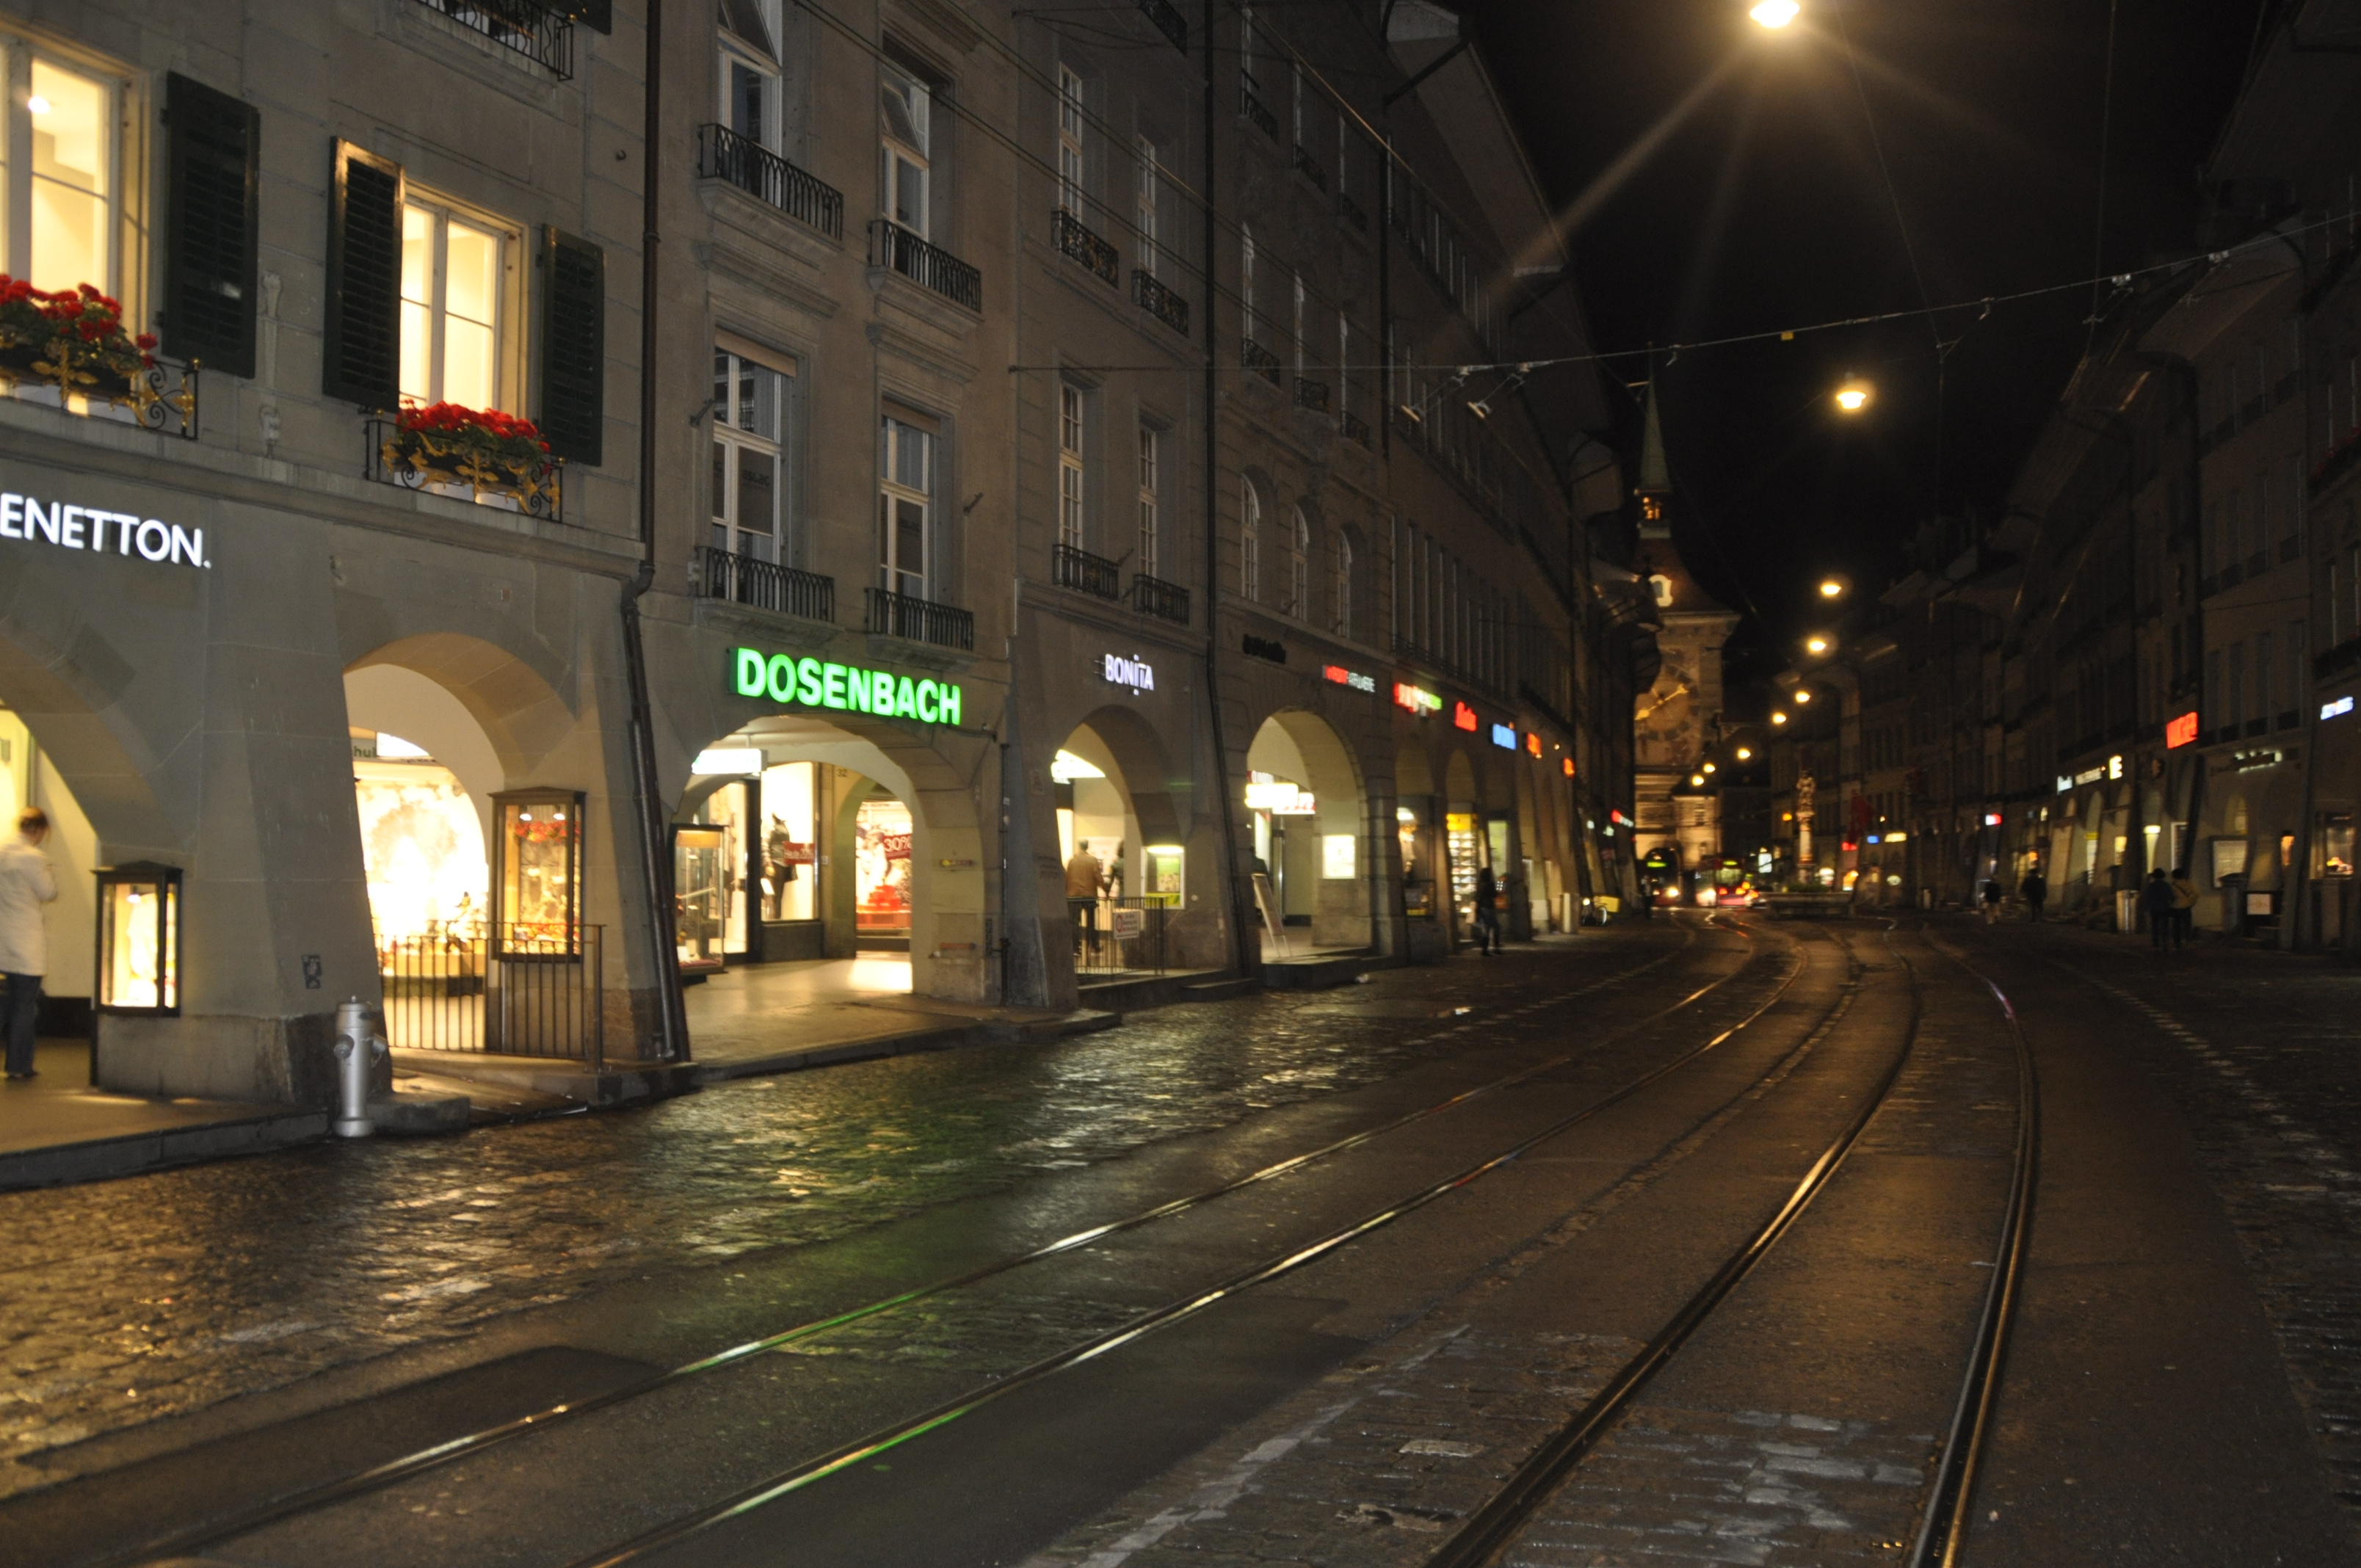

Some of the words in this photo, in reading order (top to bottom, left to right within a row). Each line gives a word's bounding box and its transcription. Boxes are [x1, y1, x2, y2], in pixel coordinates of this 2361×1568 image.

[736, 647, 961, 725] DOSENBACH
[1105, 653, 1154, 695] BONITA
[836, 769, 847, 777] 32
[883, 835, 912, 852] 30%
